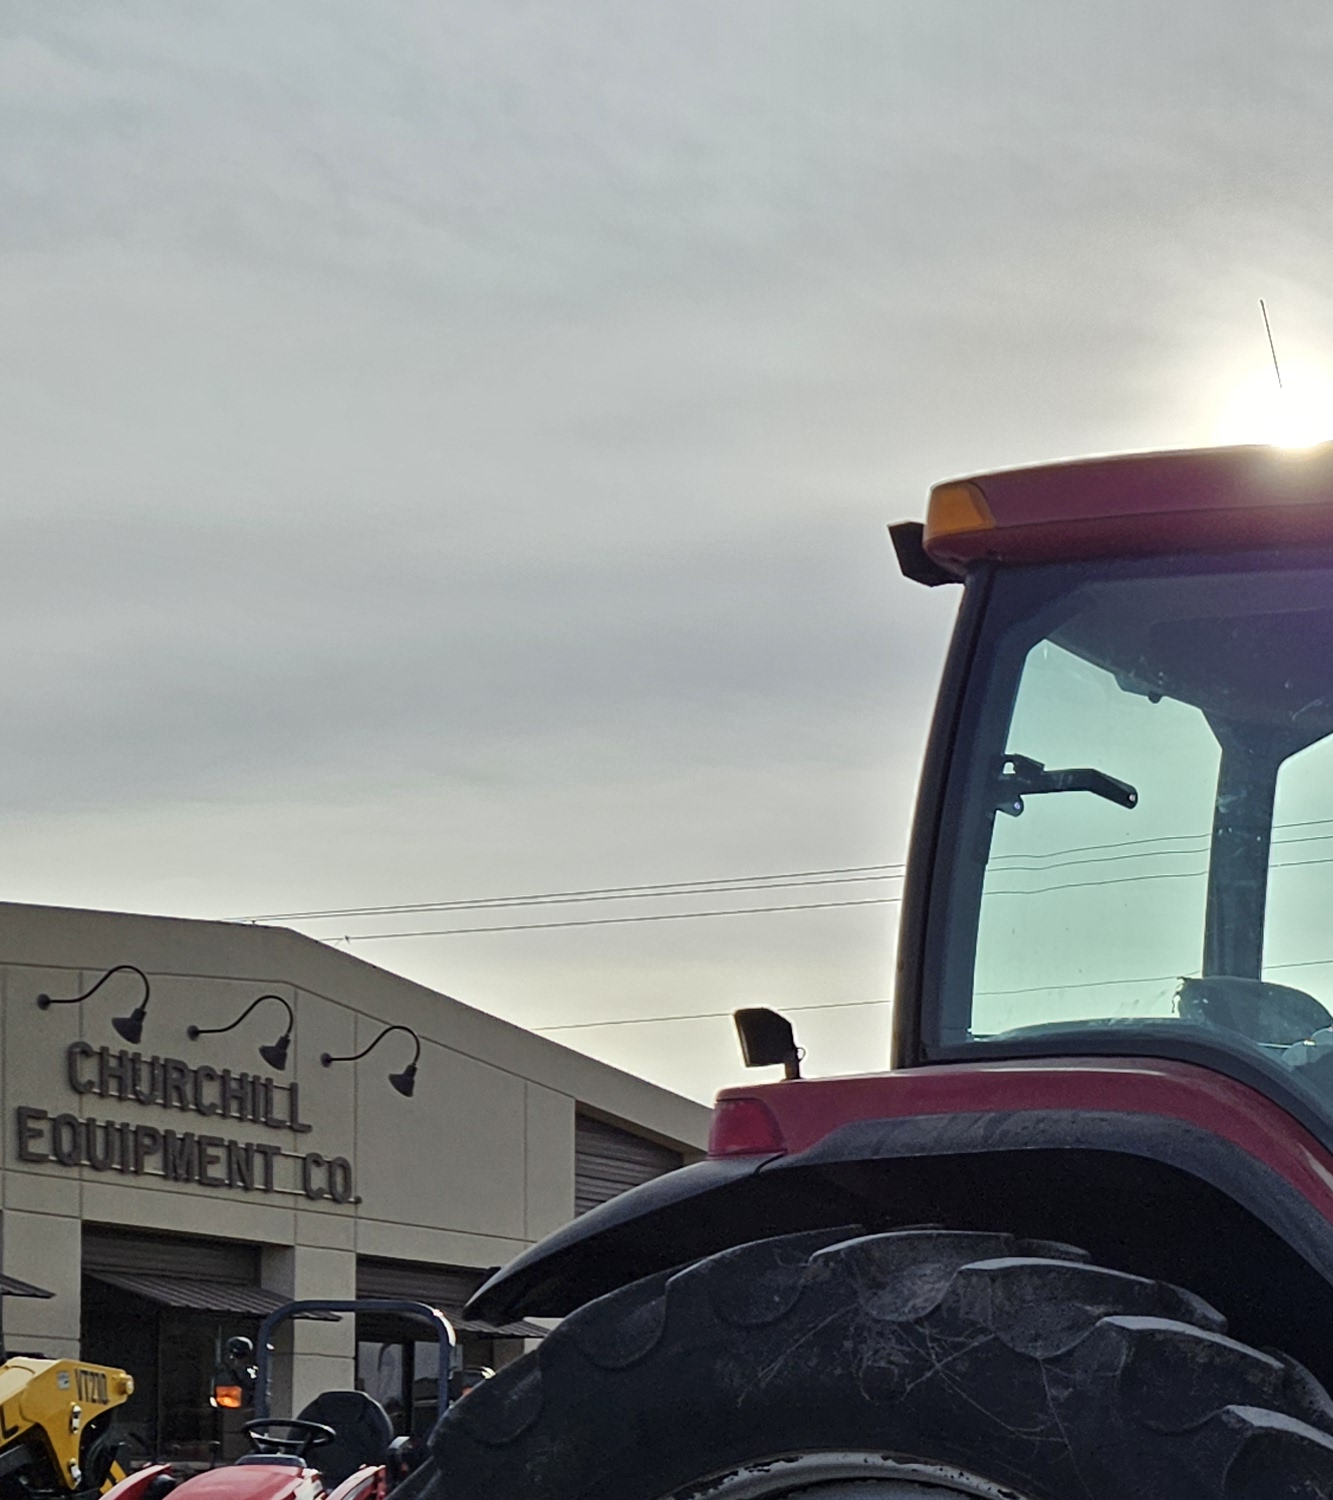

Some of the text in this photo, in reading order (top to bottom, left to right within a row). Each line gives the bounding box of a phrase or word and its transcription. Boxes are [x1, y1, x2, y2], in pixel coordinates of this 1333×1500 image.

[67, 1041, 313, 1133] CHURCHILL
[16, 1105, 363, 1205] EQUIPMENT CO.
